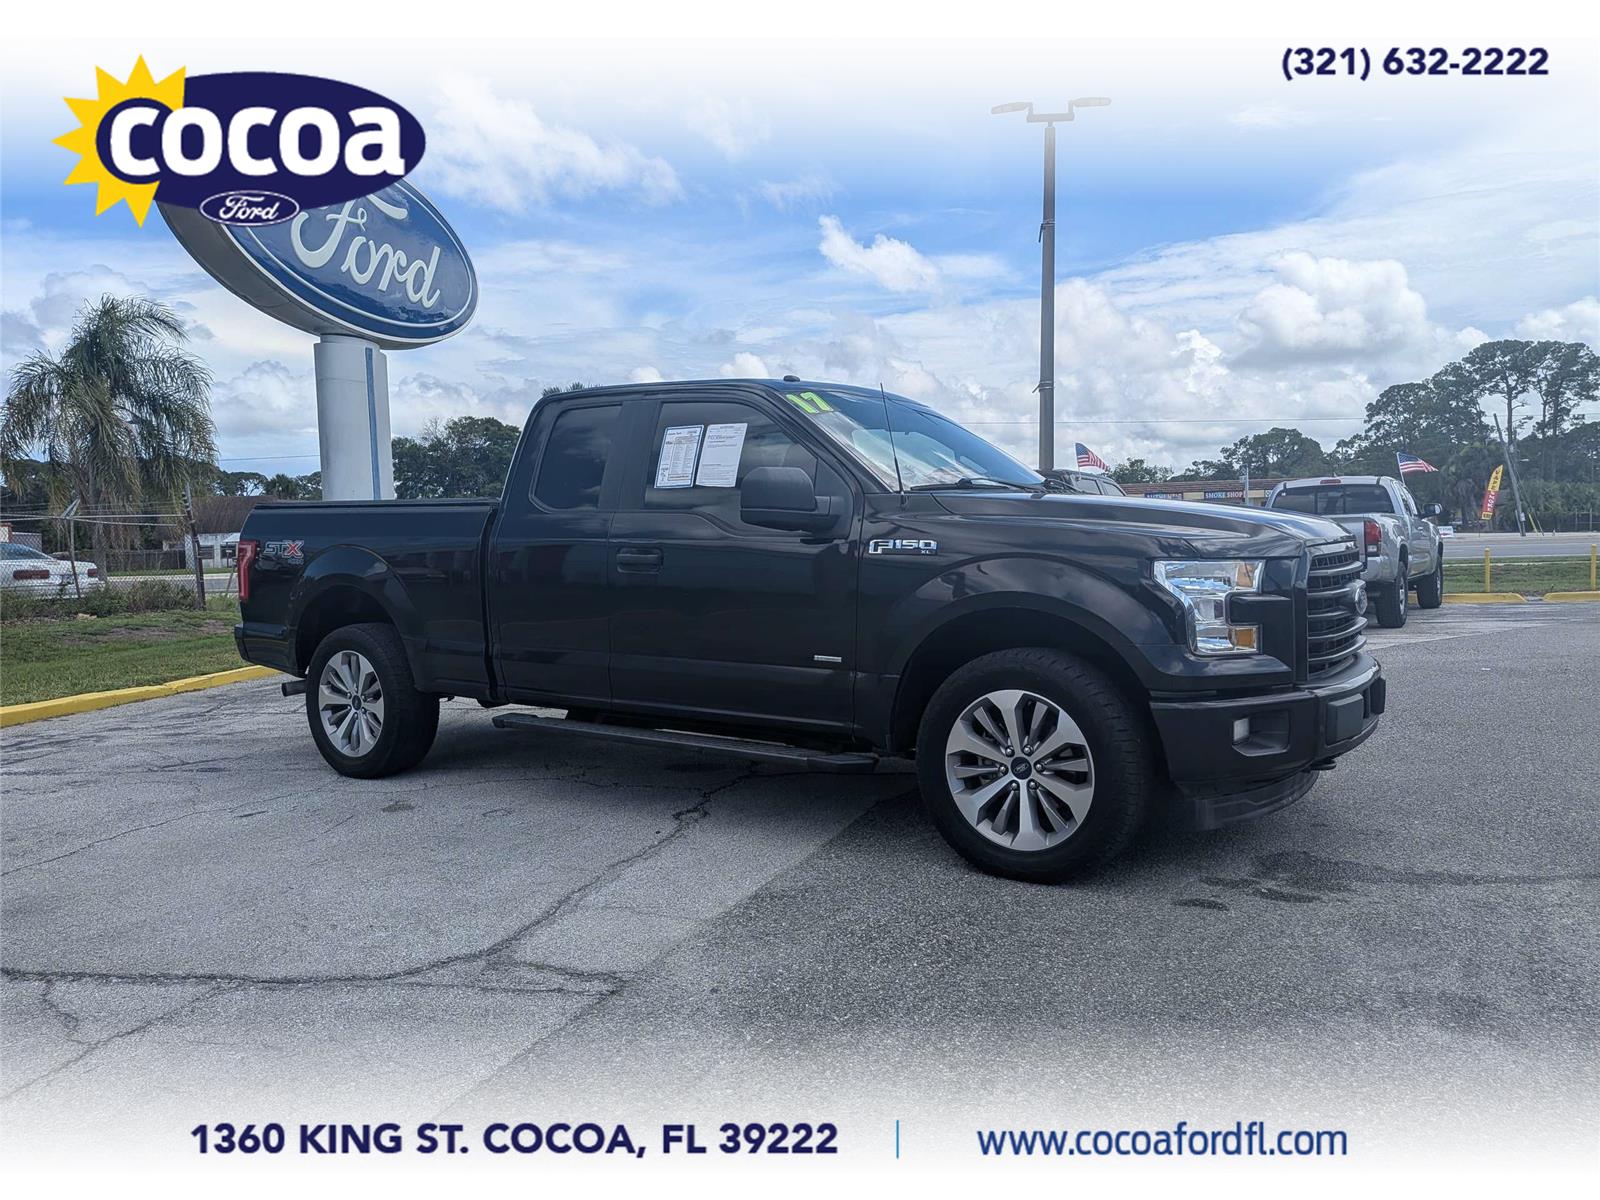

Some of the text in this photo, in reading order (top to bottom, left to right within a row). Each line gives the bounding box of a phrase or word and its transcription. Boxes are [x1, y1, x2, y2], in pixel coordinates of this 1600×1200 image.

[291, 194, 441, 308] Ford
[786, 392, 833, 413] 17
[1205, 490, 1243, 499] SMOKE SHOP
[264, 540, 304, 558] STX
